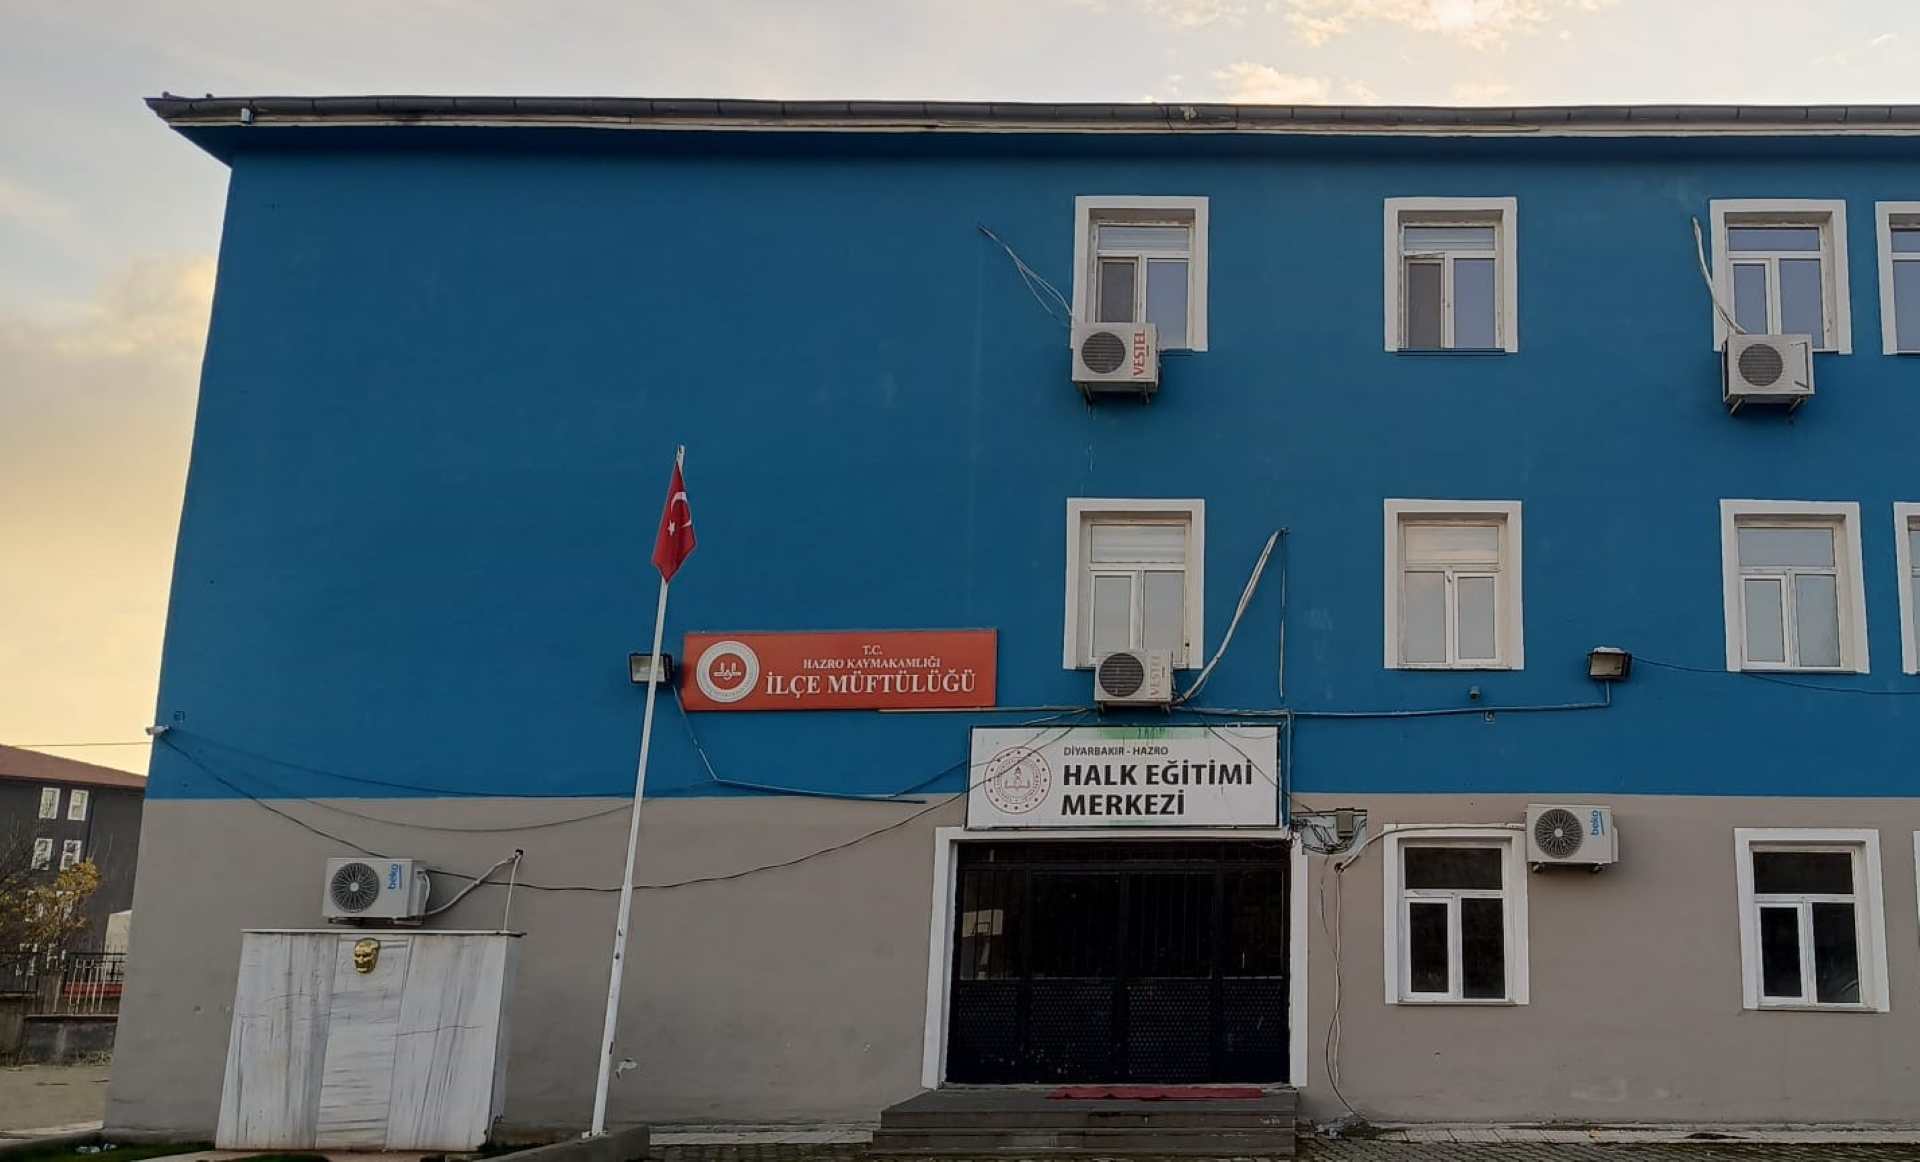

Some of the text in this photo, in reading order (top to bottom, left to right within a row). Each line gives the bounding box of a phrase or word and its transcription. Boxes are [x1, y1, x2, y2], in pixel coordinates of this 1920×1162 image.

[1133, 328, 1146, 376] VESTEL
[803, 655, 941, 669] HAZRO KAYMAKAMLIĞI
[861, 644, 883, 656] T.C.
[765, 671, 821, 698] İLÇE
[826, 669, 976, 695] MÜFTÜLÜĞÜ
[1063, 745, 1125, 756] DİYARBAKIR
[1132, 746, 1169, 756] HAZRO
[1062, 764, 1139, 786] HALK
[1145, 759, 1253, 786] EĞİTİMİ
[1060, 789, 1185, 816] MERKEZİ
[1590, 810, 1599, 836] beko
[387, 864, 399, 890] beko
